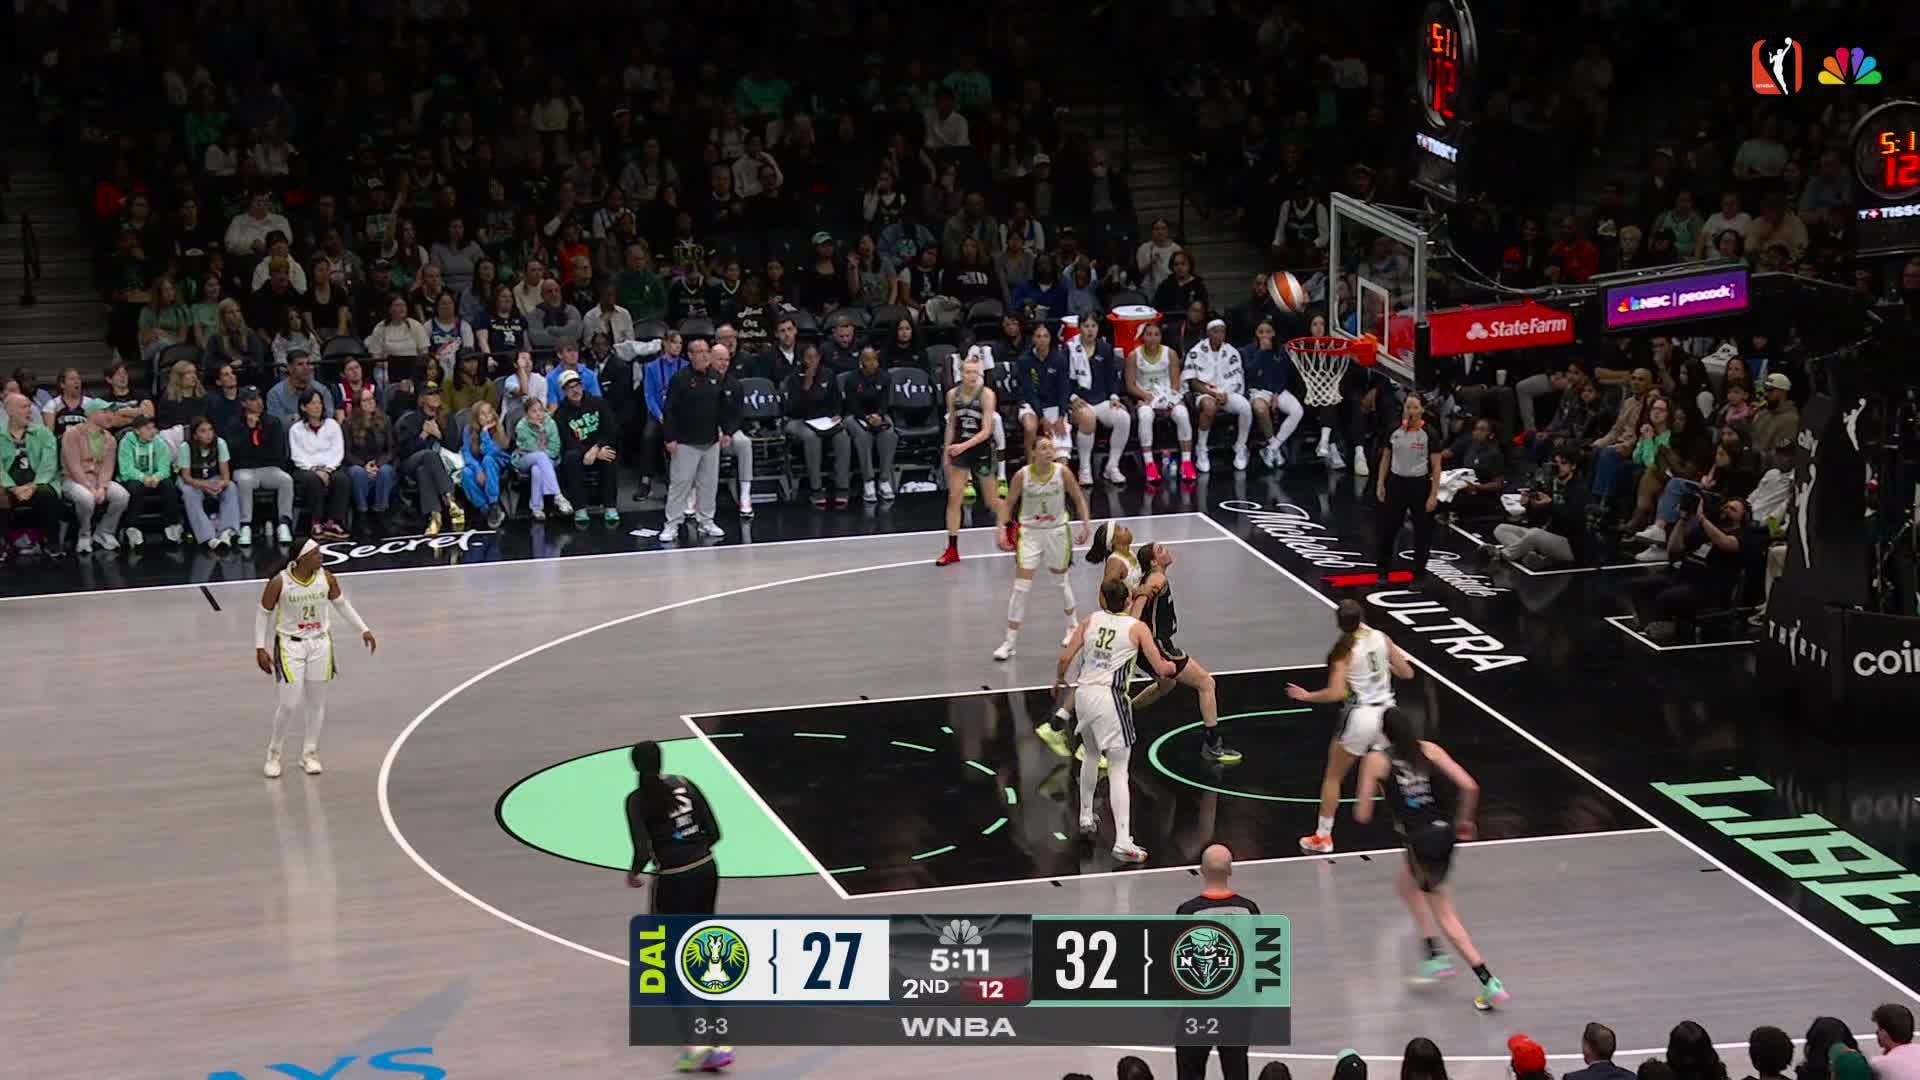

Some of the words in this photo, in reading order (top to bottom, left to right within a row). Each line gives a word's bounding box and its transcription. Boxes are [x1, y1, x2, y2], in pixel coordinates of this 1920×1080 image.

[1886, 154, 1920, 187] 12
[1640, 294, 1671, 309] NBC
[1678, 284, 1731, 306] peacock
[303, 606, 316, 620] 24
[1095, 627, 1116, 650] 32
[1366, 590, 1528, 672] ULTRA
[1650, 776, 1920, 945] LIBE
